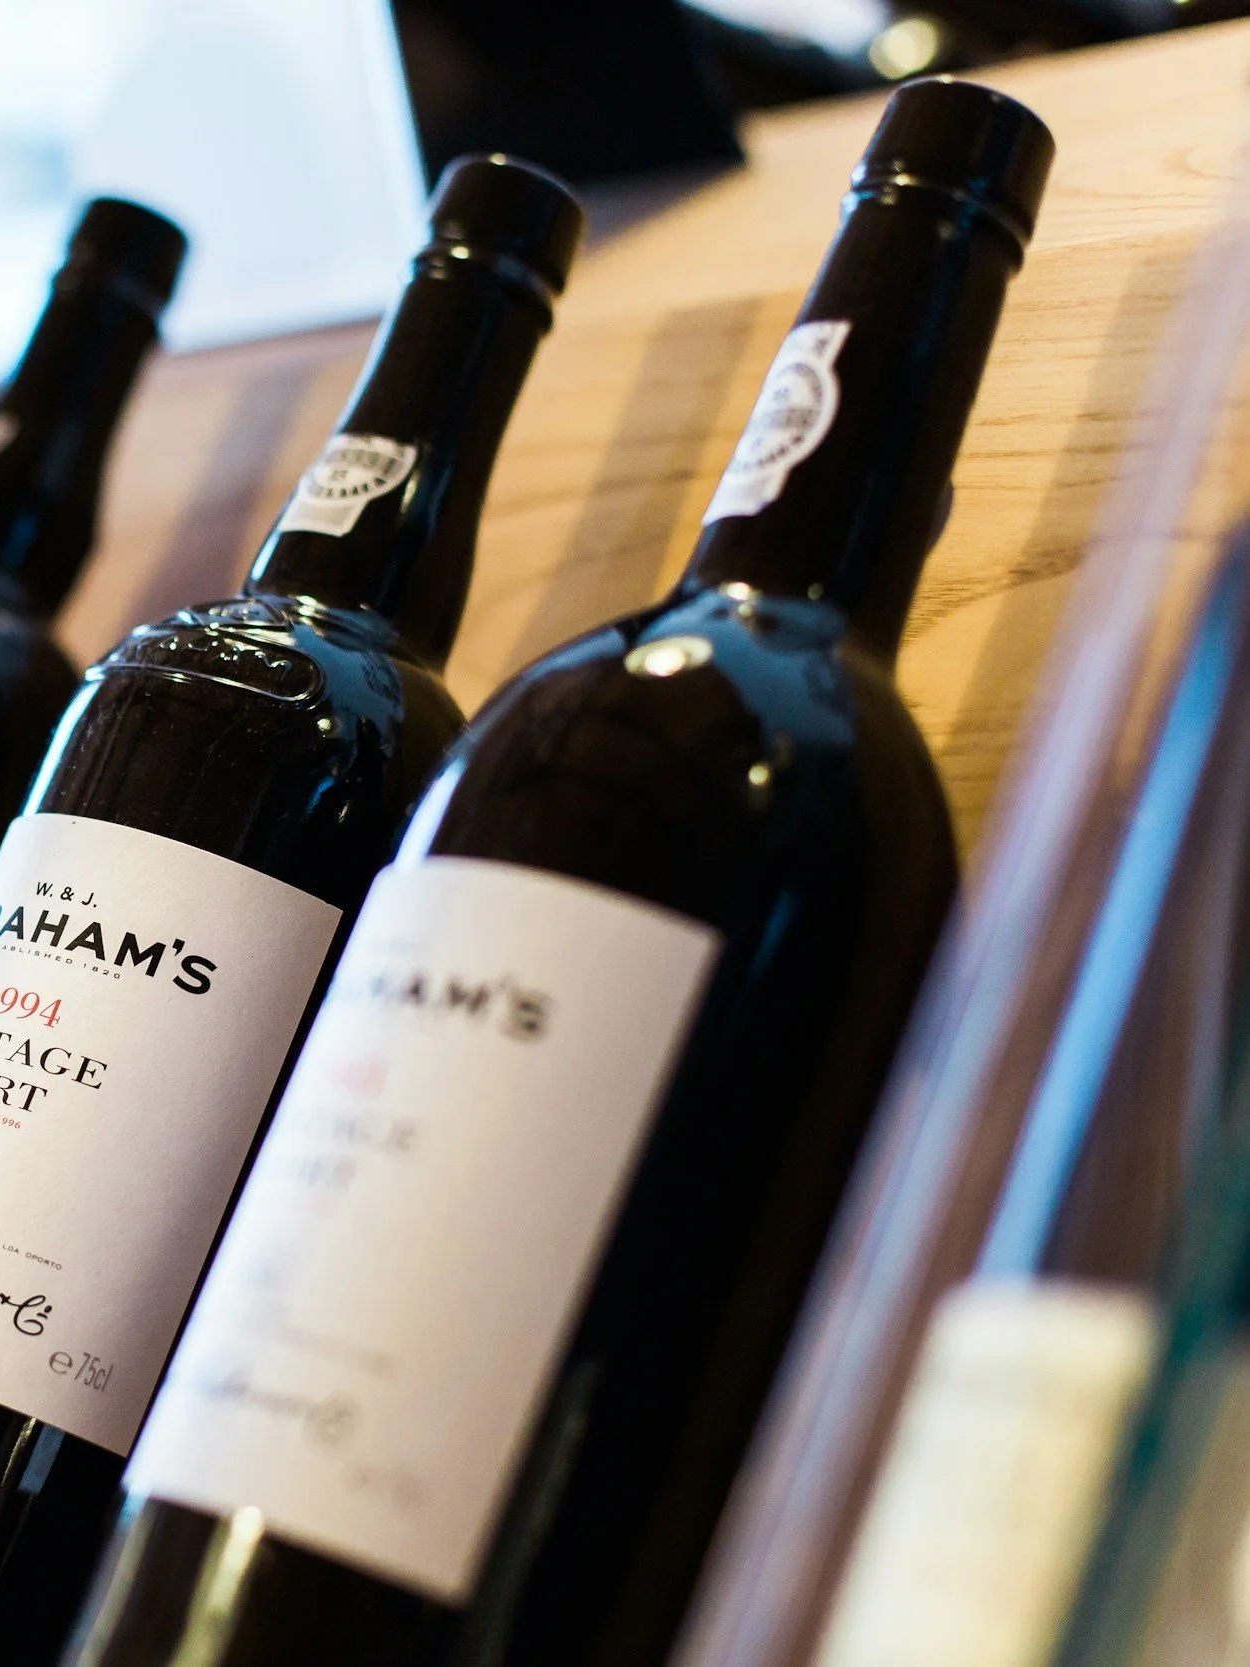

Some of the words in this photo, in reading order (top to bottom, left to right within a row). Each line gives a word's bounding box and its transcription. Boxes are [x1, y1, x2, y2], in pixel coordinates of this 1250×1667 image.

[36, 881, 54, 898] W.
[60, 886, 75, 902] &
[81, 892, 97, 908] J.
[83, 962, 122, 980] 1820
[25, 1251, 63, 1271] OPORTO
